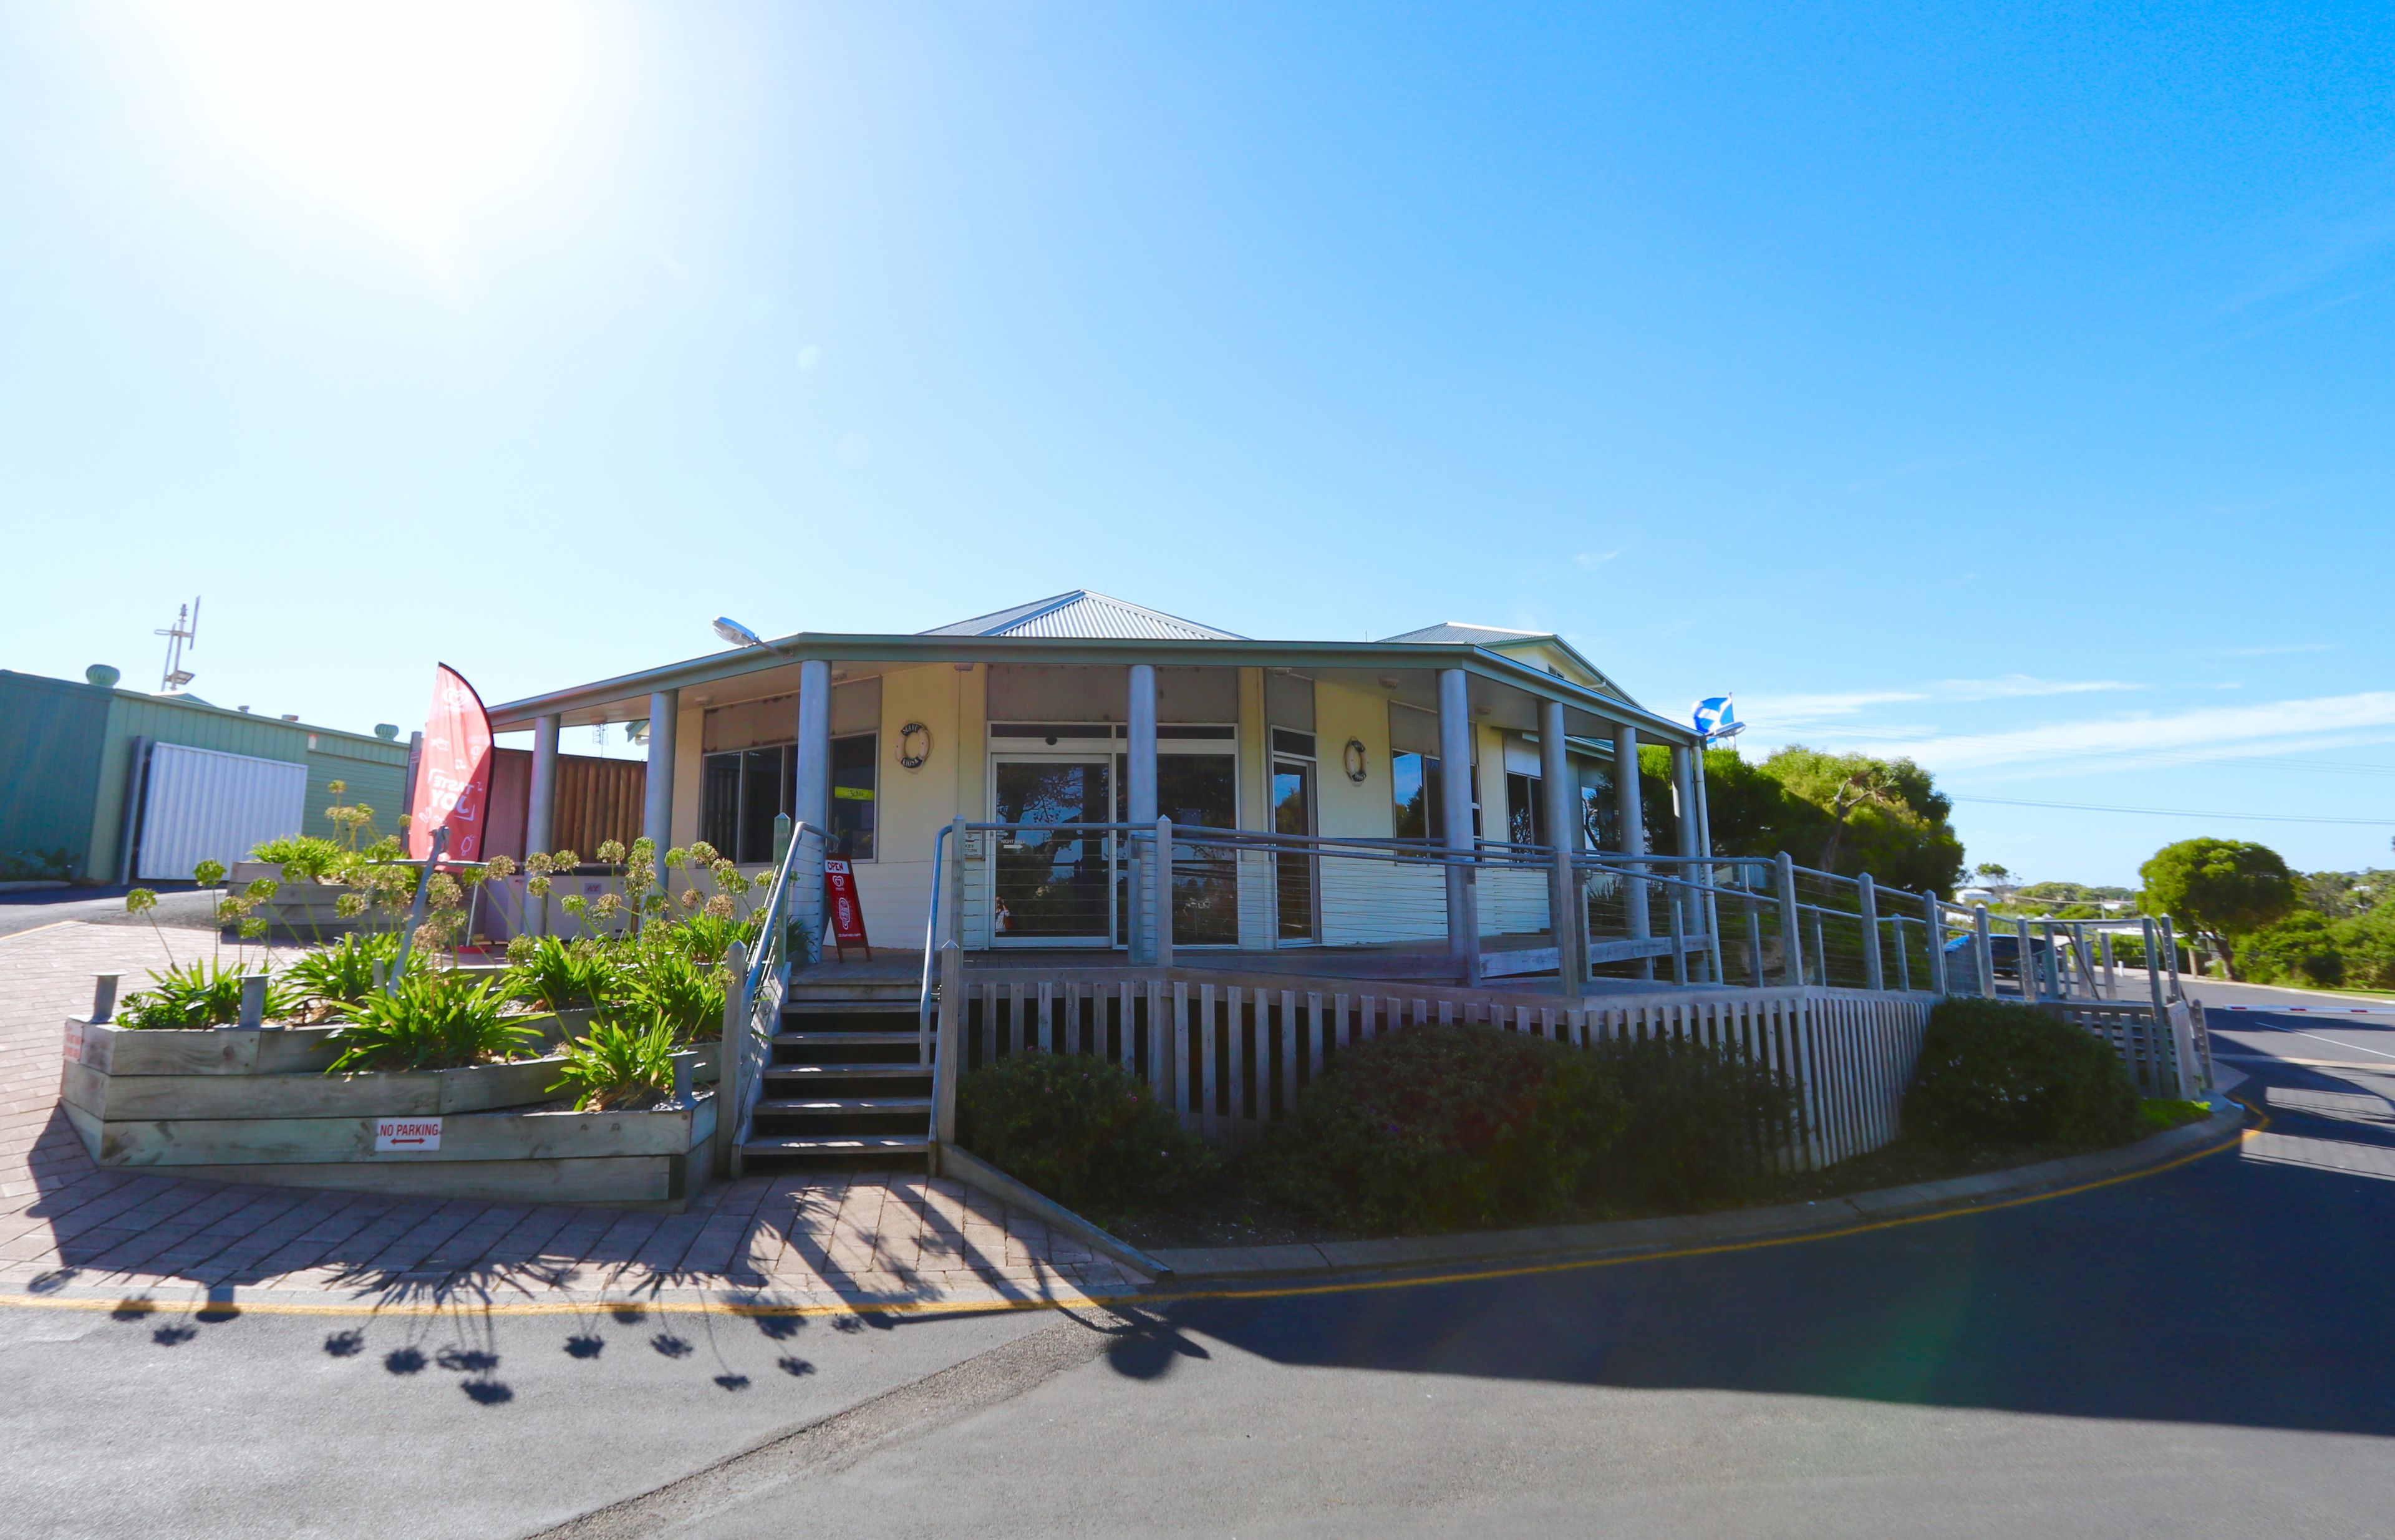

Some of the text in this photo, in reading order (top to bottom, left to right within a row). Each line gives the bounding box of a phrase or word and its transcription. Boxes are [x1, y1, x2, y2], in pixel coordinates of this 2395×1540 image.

[827, 861, 844, 871] OPEN
[380, 1123, 438, 1136] NO PARKING
